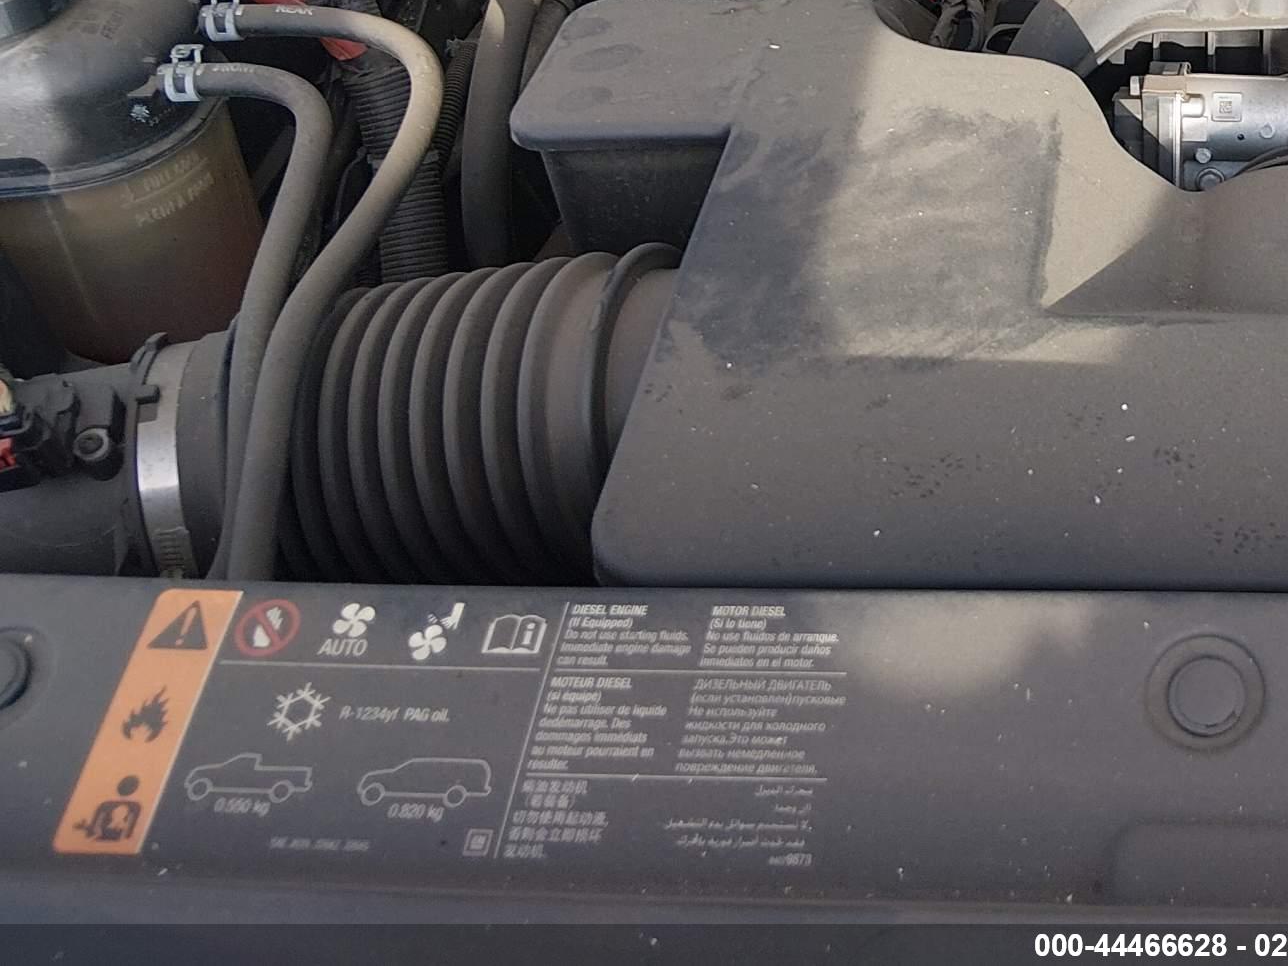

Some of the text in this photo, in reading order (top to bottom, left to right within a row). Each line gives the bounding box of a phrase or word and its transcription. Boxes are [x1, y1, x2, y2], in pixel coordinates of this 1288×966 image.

[571, 604, 649, 616] DIESEL ENGINE
[711, 605, 786, 617] MOTOR DIESEL
[316, 638, 368, 656] AUTO
[549, 676, 632, 689] MOTEUR DIESEL
[403, 707, 431, 722] PAG
